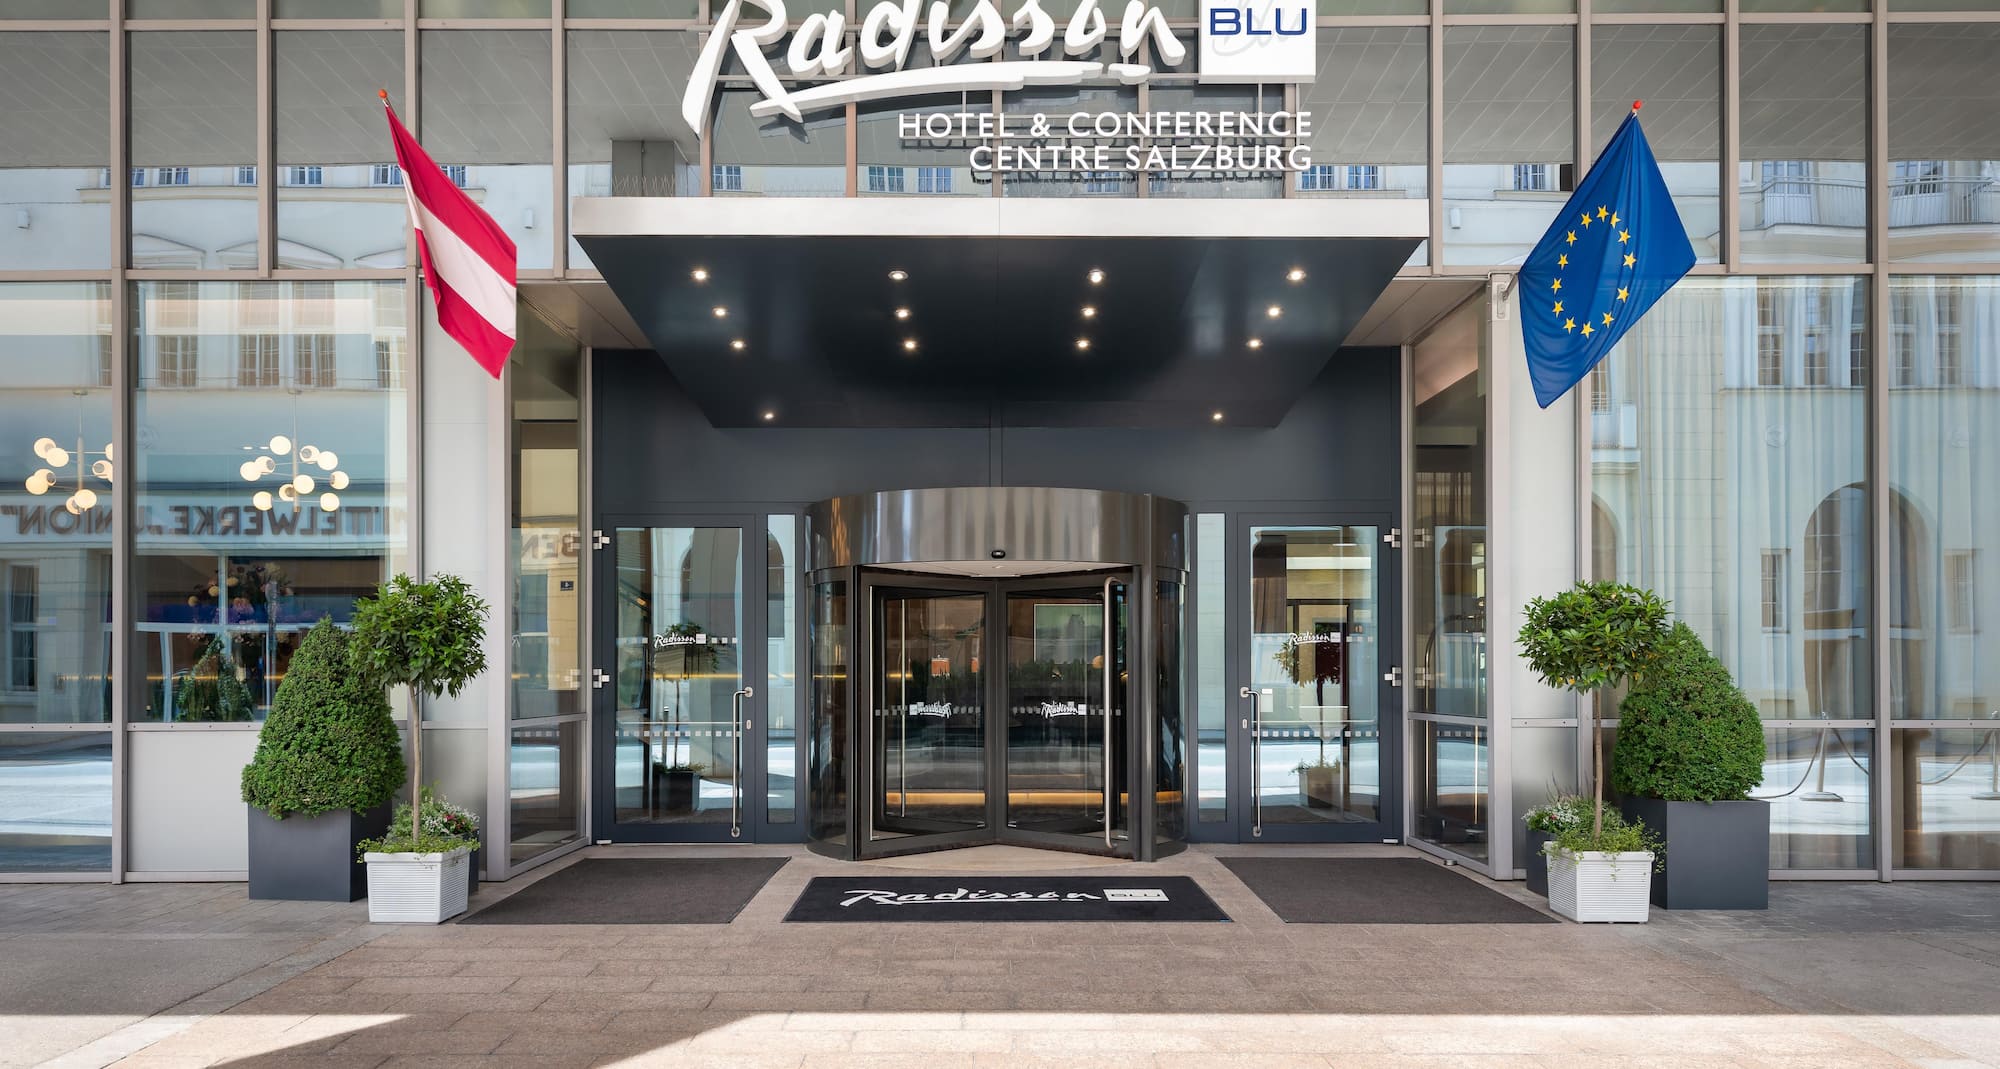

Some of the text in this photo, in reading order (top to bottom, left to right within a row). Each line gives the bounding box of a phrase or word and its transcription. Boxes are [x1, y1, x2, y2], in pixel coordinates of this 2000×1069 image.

[682, 0, 1186, 139] Radisson
[1210, 8, 1307, 35] BLU
[898, 111, 1312, 138] HOTEL & CONFERENCE
[969, 145, 1312, 171] CENTRE SALZBURG
[654, 632, 696, 649] Radisson
[1289, 631, 1330, 646] Radisson
[839, 887, 1102, 907] Radisson
